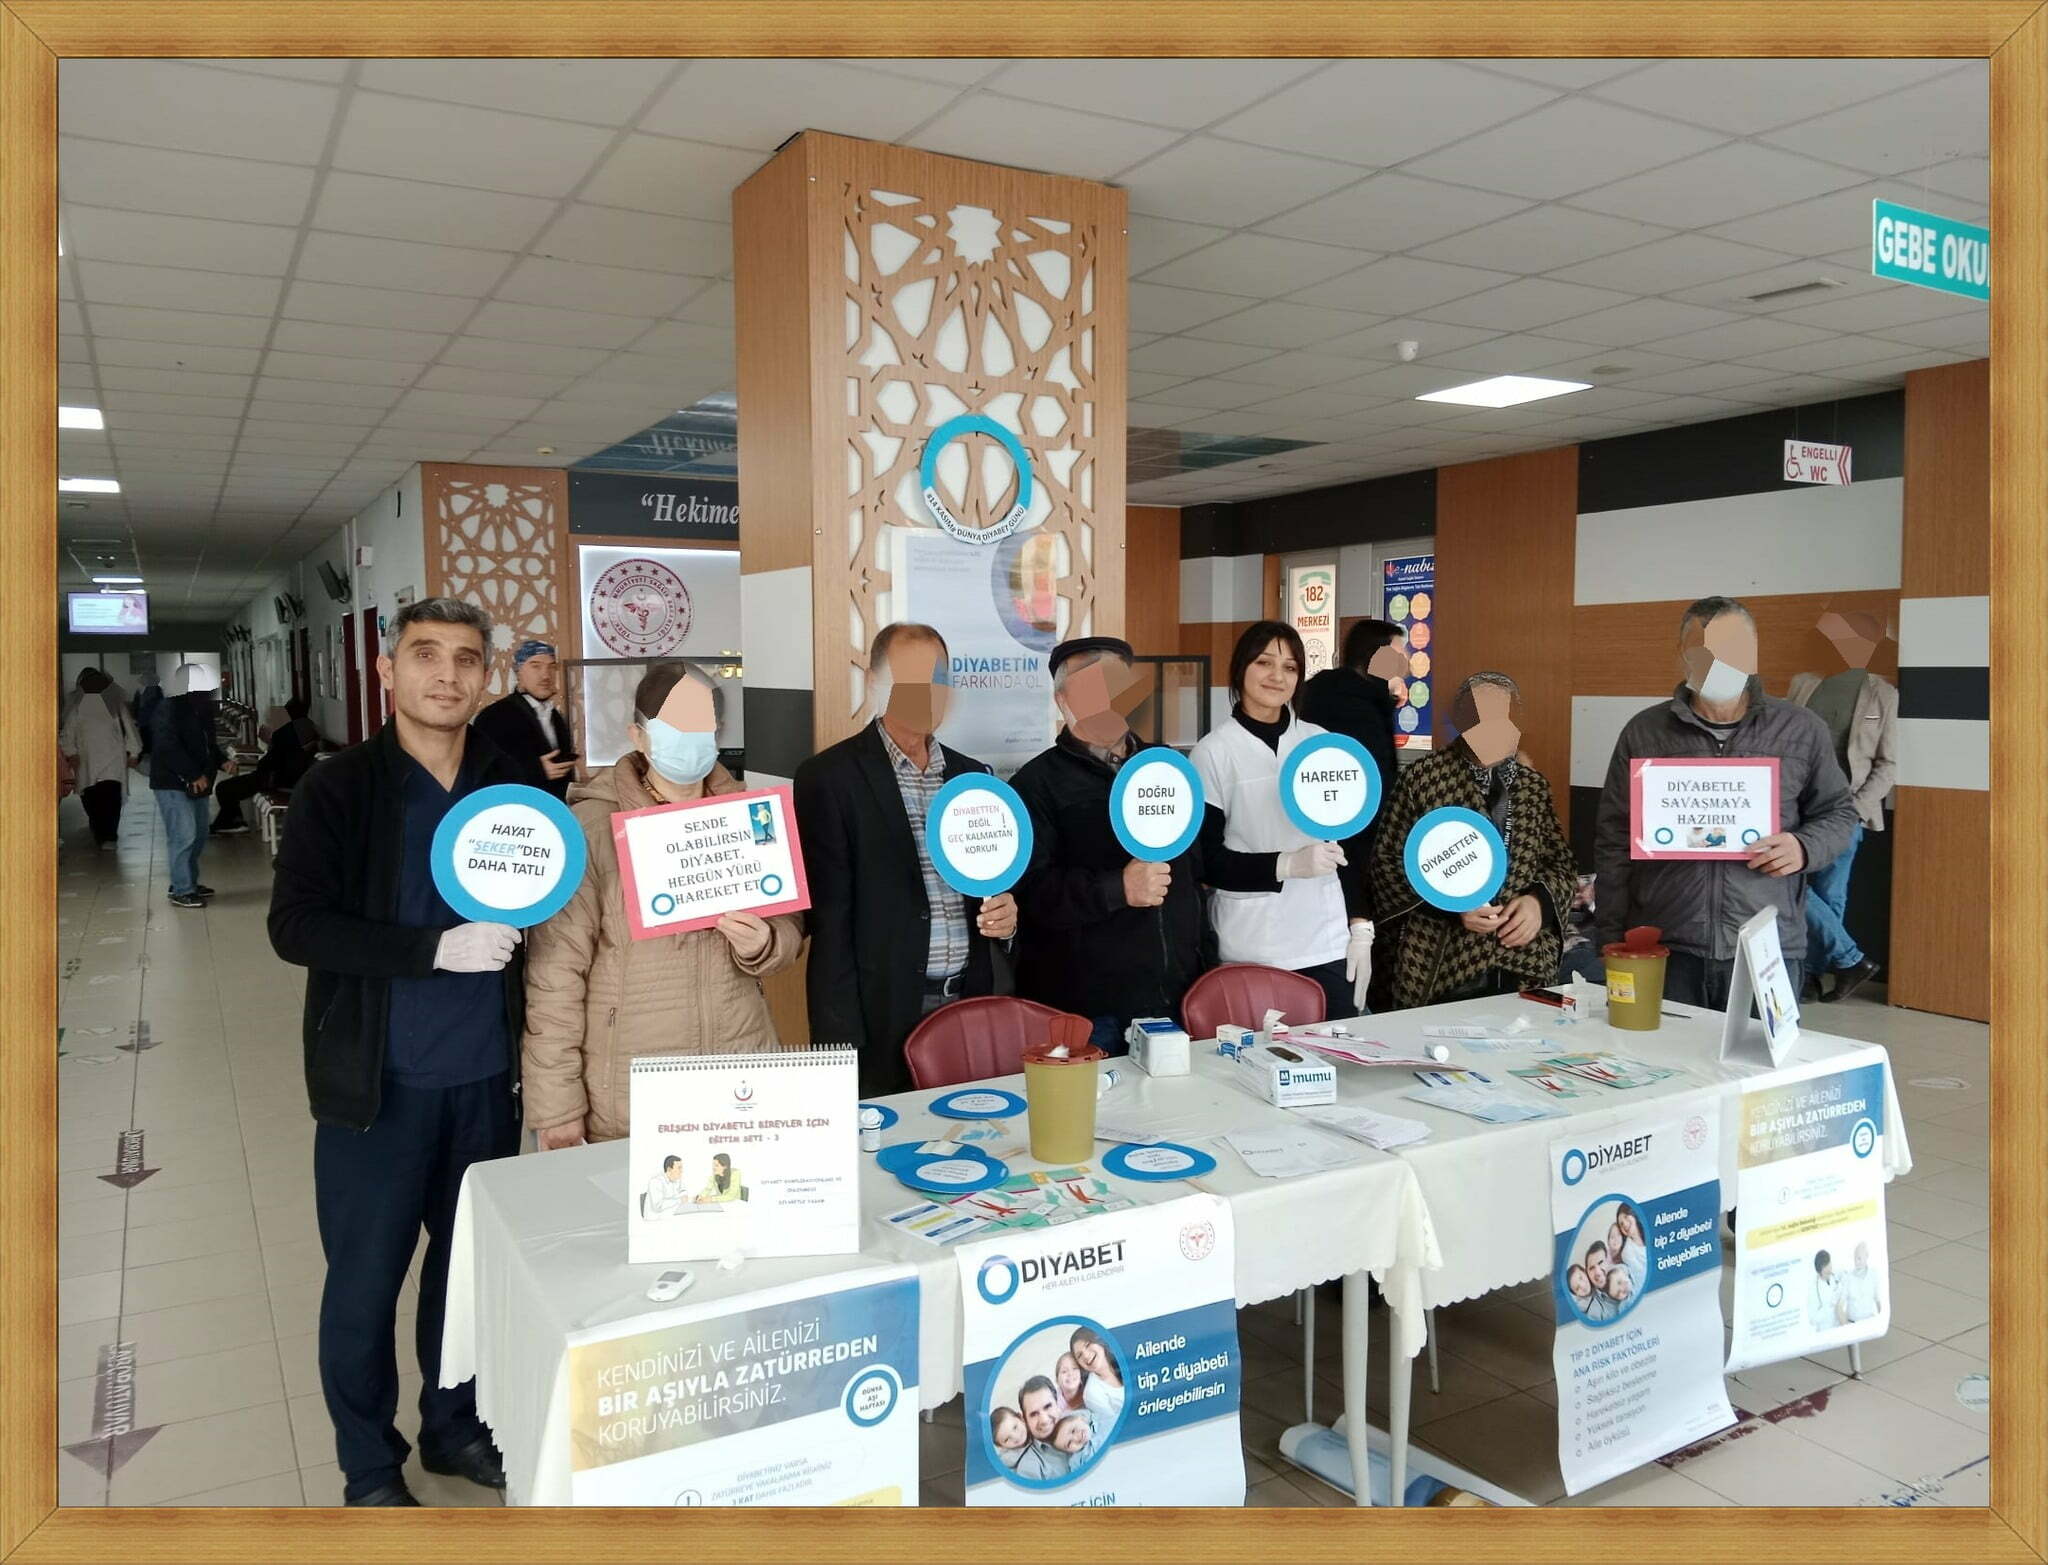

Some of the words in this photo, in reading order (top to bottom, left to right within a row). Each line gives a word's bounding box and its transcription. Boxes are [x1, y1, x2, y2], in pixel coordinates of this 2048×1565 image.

[1877, 216, 1936, 275] GEBE
[1810, 466, 1828, 482] WC
[956, 528, 982, 541] DÜNYA
[982, 525, 1009, 542] DİYABET
[1305, 585, 1324, 602] 182
[952, 655, 1039, 673] DİYABETİN
[952, 675, 1023, 689] FARKINDA
[1025, 675, 1043, 688] OL
[1300, 769, 1360, 783] HAREKET
[1137, 785, 1176, 799] DOĞRU
[1667, 779, 1747, 792] DİYABETLE
[1323, 790, 1339, 802] ET
[1660, 797, 1752, 810] SAVAŞMAYA
[1138, 804, 1175, 816] BESLEN
[684, 816, 729, 834] SENDE
[1677, 814, 1737, 826] HAZIRIM
[491, 824, 536, 838] HAYAT
[965, 829, 1014, 842] KALMAKTAN
[666, 828, 752, 855] OLABİLİRSİN
[965, 843, 998, 855] KORKUN
[1421, 831, 1480, 874] DİYABETTEN
[468, 858, 507, 873] DAHA
[1442, 851, 1479, 879] KORUN
[668, 867, 723, 889] HERGÜN
[726, 859, 763, 878] YÜRÜ
[675, 882, 740, 906] HAREKET
[744, 879, 761, 892] ET
[1292, 1070, 1332, 1085] mumu
[1805, 1098, 1867, 1123] ZATÜRREDEN
[703, 1120, 755, 1132] DİYABETLİ
[1588, 1134, 1653, 1170] DİYABET
[1669, 1231, 1675, 1243] 2
[597, 1343, 702, 1388] KENDİNİZİ
[709, 1340, 736, 1363] VE
[743, 1317, 821, 1358] AİLENİZİ
[1135, 1333, 1186, 1360] Ailende
[598, 1385, 639, 1417] BİR
[645, 1371, 730, 1409] AŞIYLA
[736, 1334, 878, 1386] ZATÜRREDEN
[1137, 1371, 1158, 1391] tip
[1161, 1367, 1171, 1384] 2
[1173, 1352, 1229, 1383] diyabeti
[859, 1400, 887, 1412] HAFTASI
[1138, 1382, 1226, 1416] önleyebilirsin
[598, 1382, 788, 1445] KORUYABİLİRSİNİZ.
